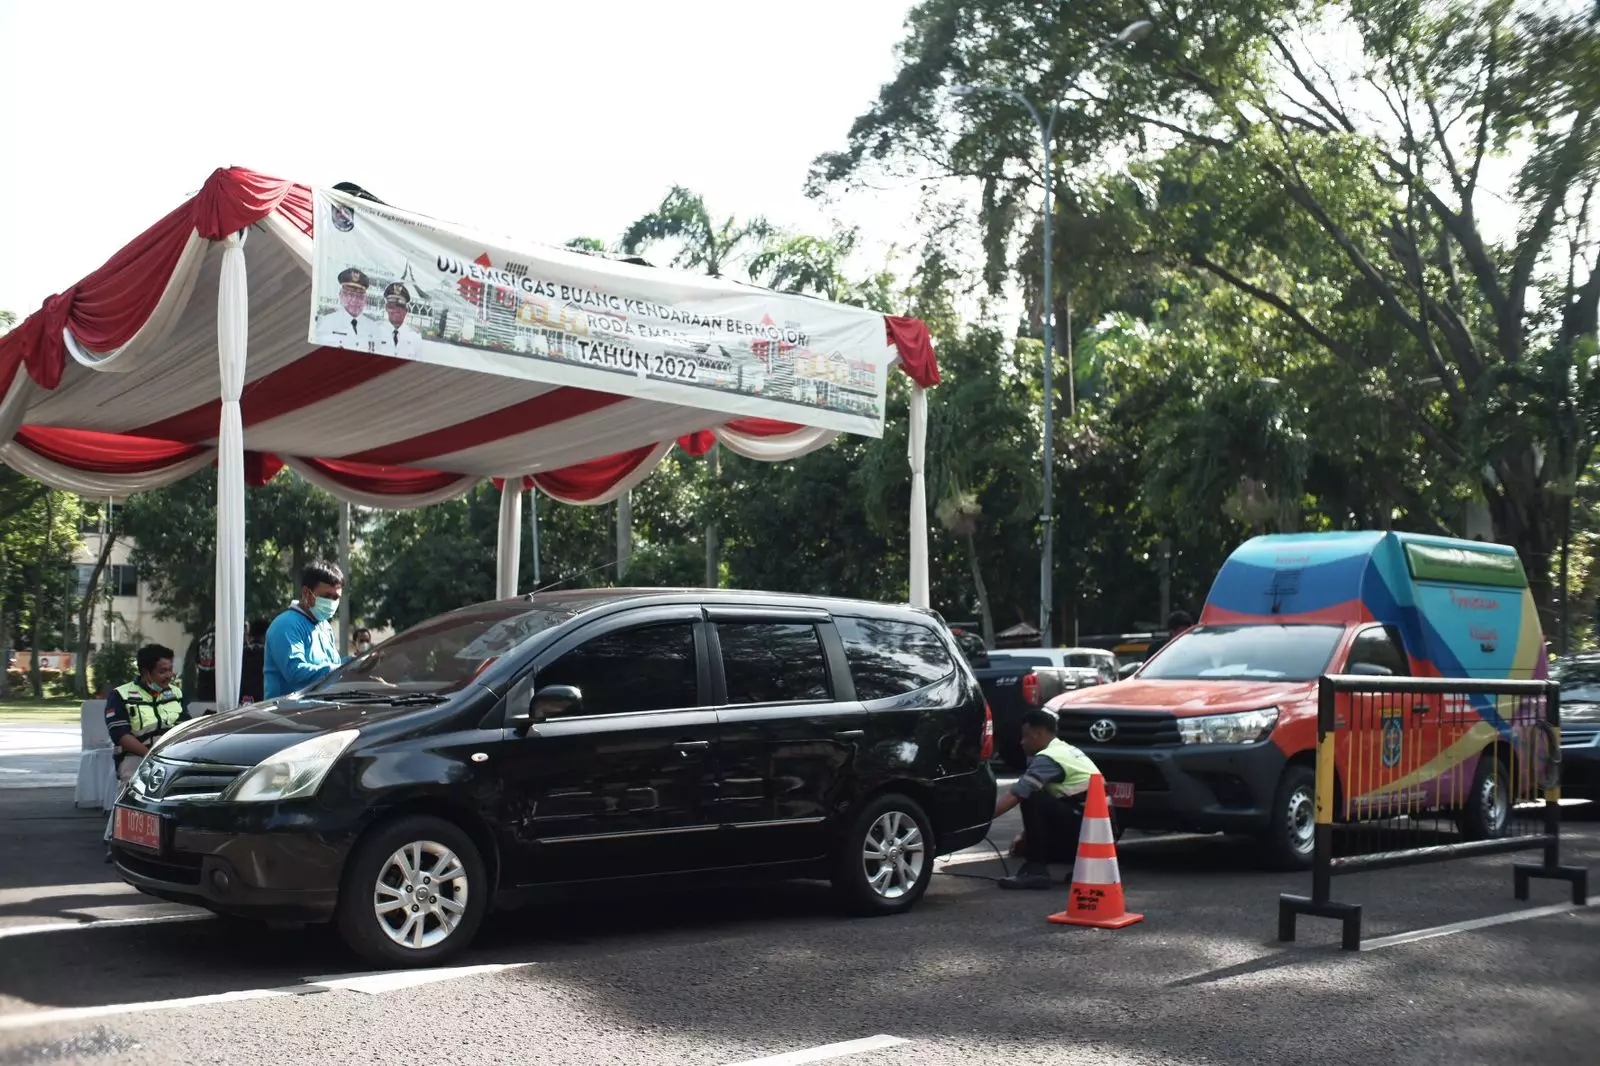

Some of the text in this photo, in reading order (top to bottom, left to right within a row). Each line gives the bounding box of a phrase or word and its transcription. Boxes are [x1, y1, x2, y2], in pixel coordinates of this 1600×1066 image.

[437, 255, 807, 346] UJI EMISI GAS BUANG KENDARAAN BERMOTOR
[586, 315, 689, 339] RODA EMP
[577, 340, 697, 379] TAHUN 2022
[128, 811, 144, 833] 1079
